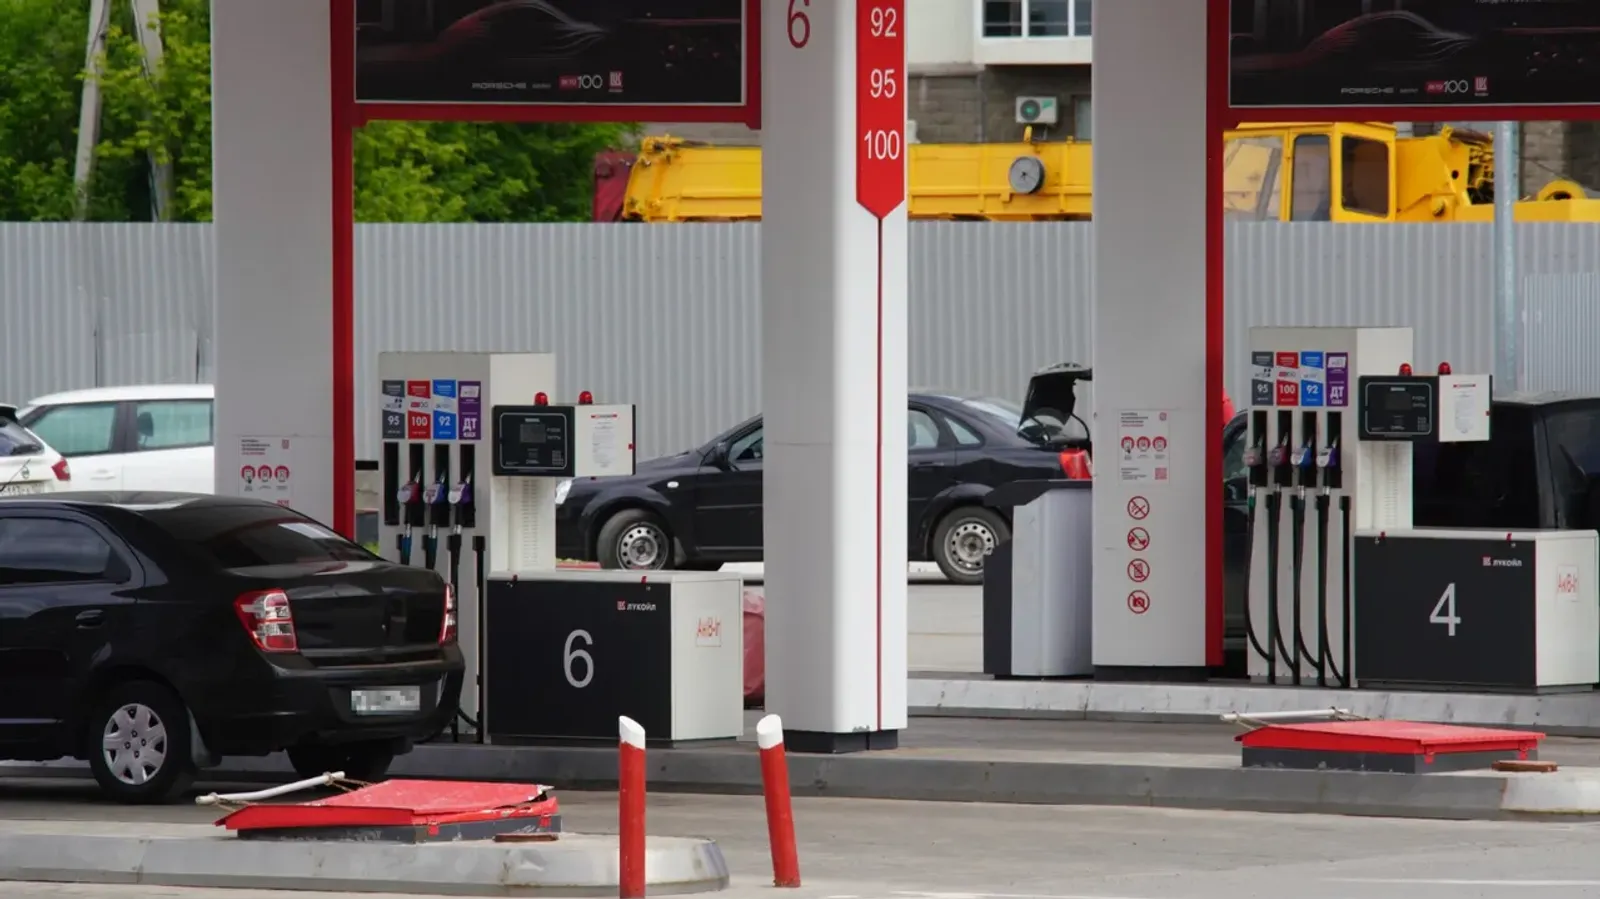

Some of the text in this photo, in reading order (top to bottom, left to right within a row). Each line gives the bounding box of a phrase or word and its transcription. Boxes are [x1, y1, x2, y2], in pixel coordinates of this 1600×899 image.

[787, 0, 810, 48] 6
[870, 7, 897, 37] 92
[577, 74, 604, 89] 100
[870, 68, 896, 98] 95
[1443, 79, 1469, 93] 100
[864, 130, 900, 160] 100
[1257, 384, 1269, 394] 95
[1280, 385, 1295, 394] 100
[1306, 385, 1319, 394] 92
[1330, 386, 1344, 400] ДТ
[387, 415, 400, 426] 95
[411, 416, 428, 427] 100
[438, 415, 451, 426] 92
[462, 417, 478, 433] ДТ
[626, 602, 656, 611] ЛУКОЙЛ
[1429, 582, 1461, 636] 4
[563, 629, 594, 688] 6
